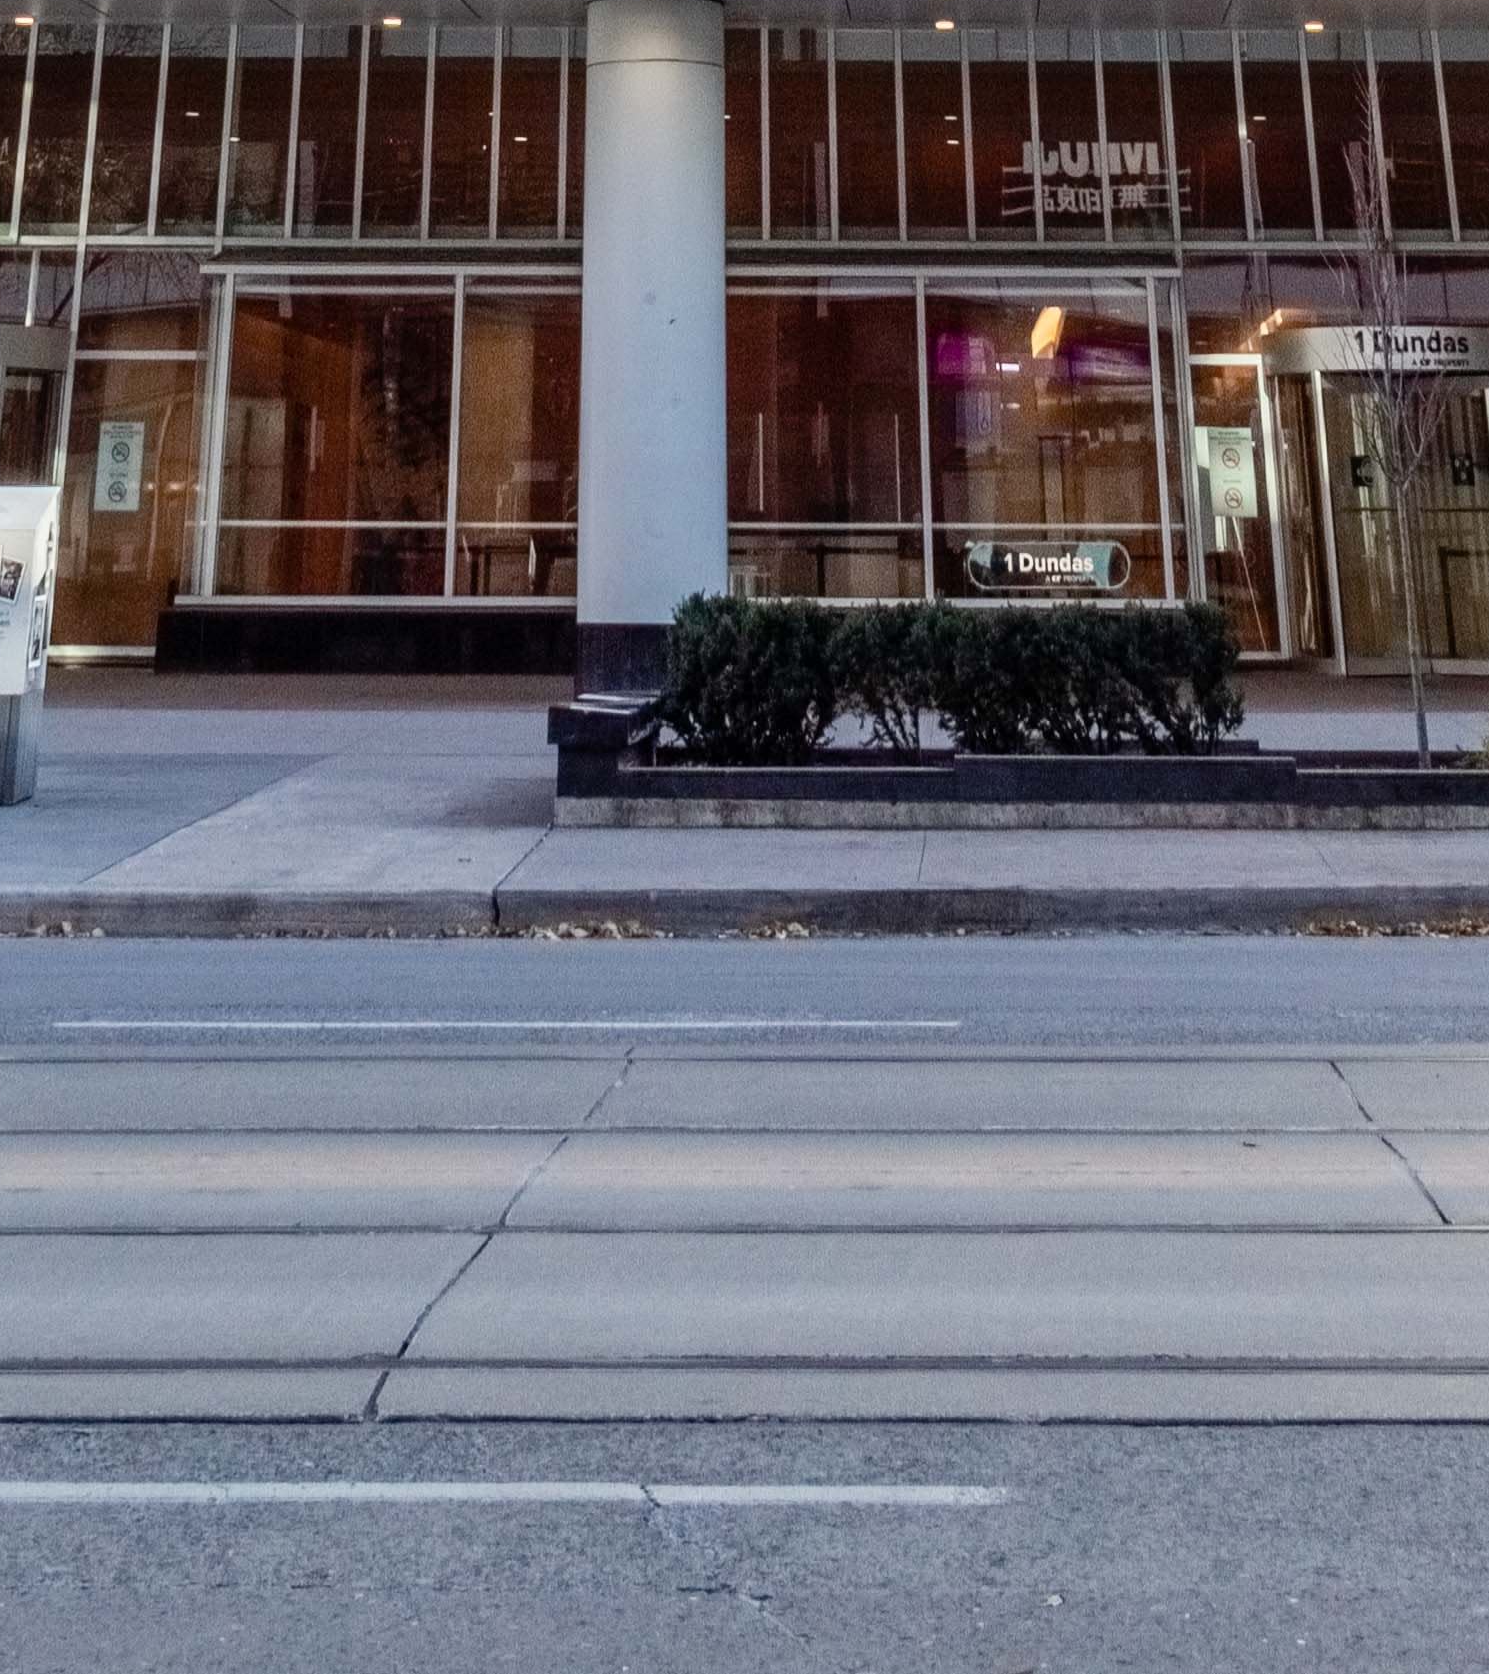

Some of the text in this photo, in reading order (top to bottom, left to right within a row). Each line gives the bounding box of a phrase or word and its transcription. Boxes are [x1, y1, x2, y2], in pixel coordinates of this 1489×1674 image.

[1355, 330, 1470, 354] 1 Dundas
[1004, 552, 1095, 573] 1 Dundas
